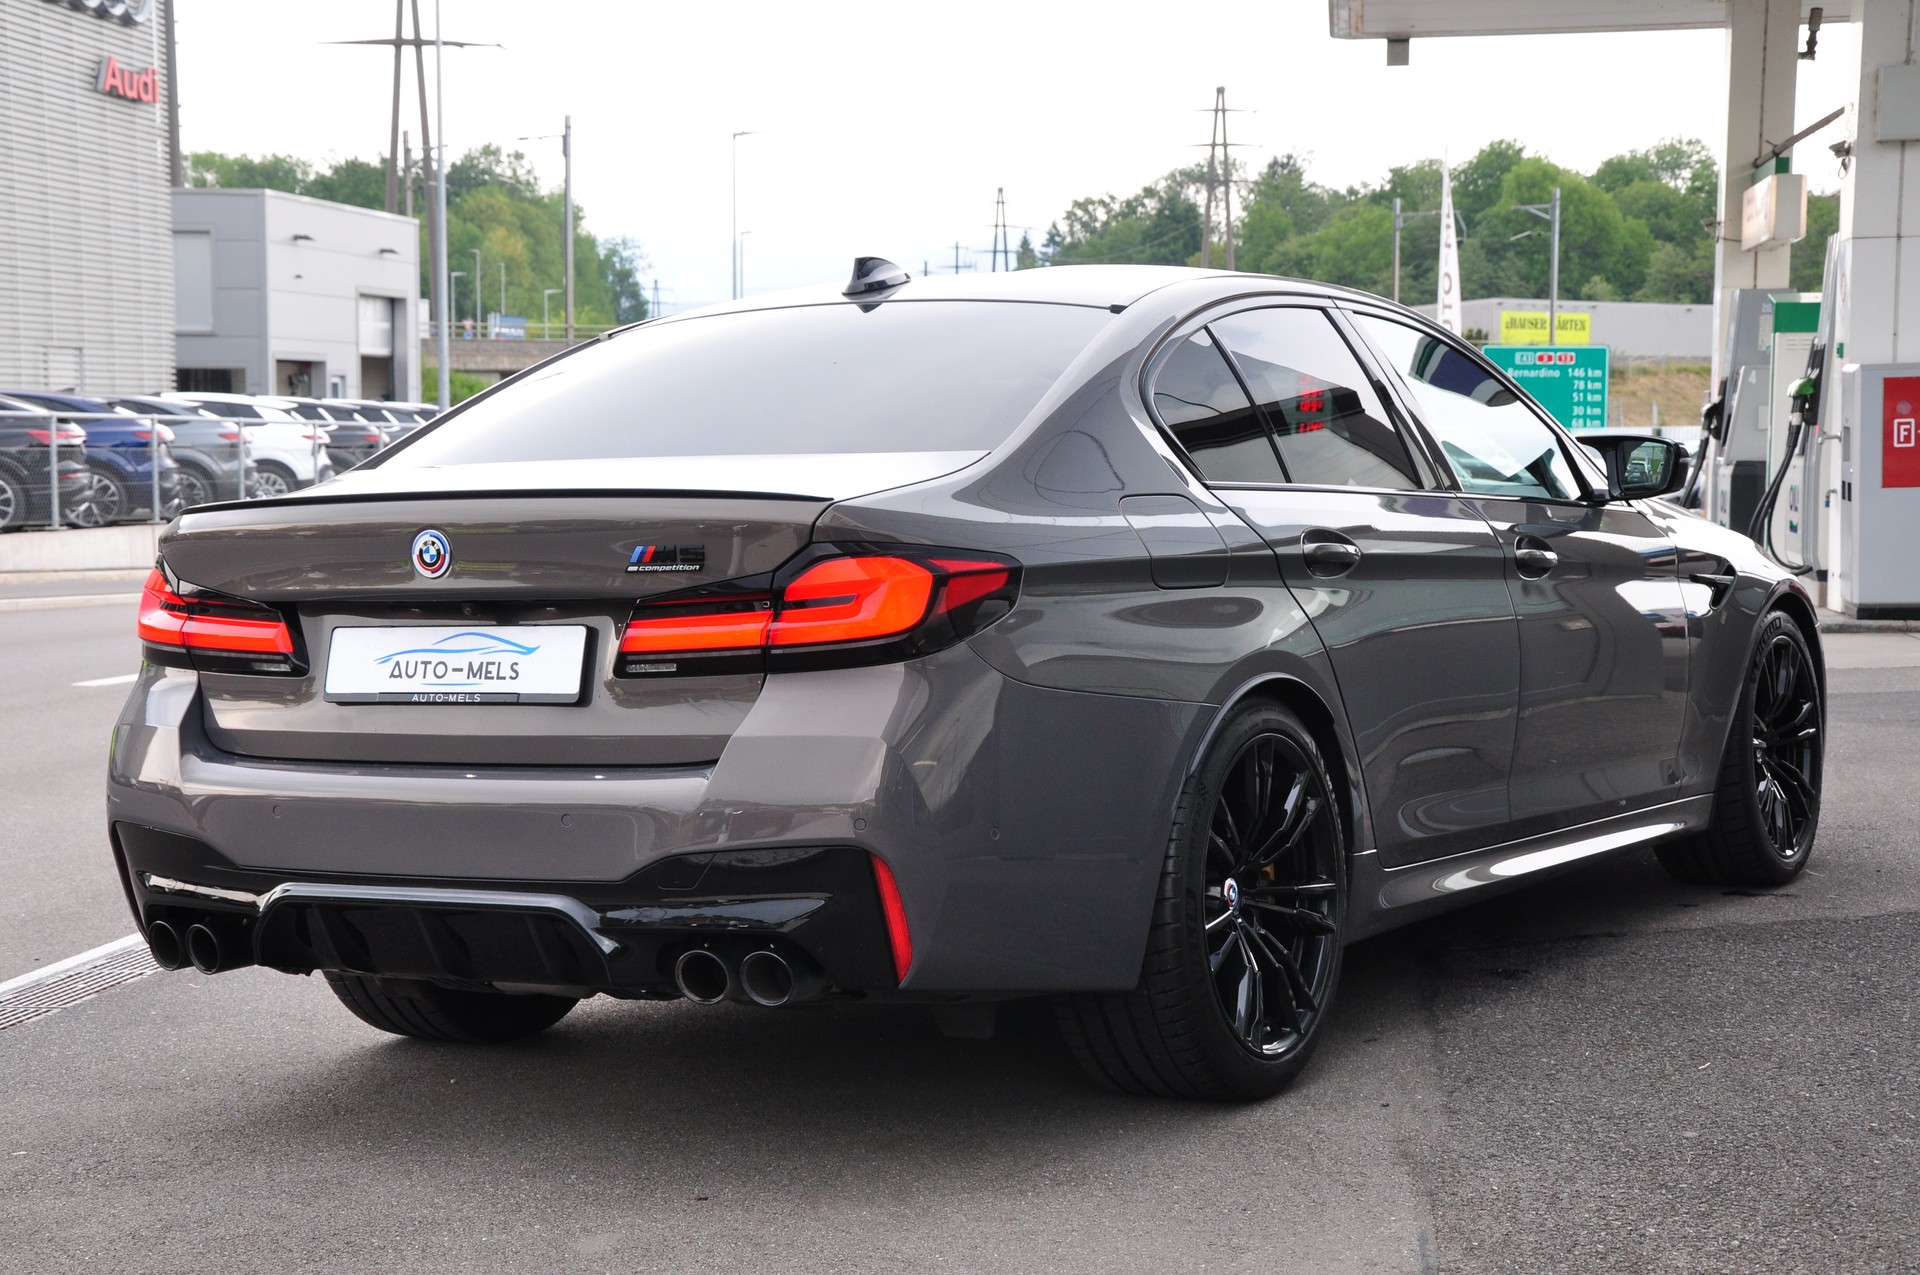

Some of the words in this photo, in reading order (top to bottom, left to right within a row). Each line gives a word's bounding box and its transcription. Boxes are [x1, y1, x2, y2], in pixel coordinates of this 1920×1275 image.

[103, 53, 160, 104] Audi
[1555, 315, 1586, 332] ÄRTEN
[1507, 368, 1561, 378] Bernardino
[1568, 368, 1585, 378] 146
[1587, 368, 1603, 378] km
[1748, 369, 1757, 385] 4
[1573, 380, 1585, 390] 78
[1587, 380, 1602, 390] km
[1572, 392, 1584, 402] 51
[1587, 392, 1602, 402] km
[1572, 405, 1584, 416] 30
[1586, 405, 1601, 416] km
[1586, 418, 1601, 429] km
[1900, 425, 1910, 442] F
[638, 564, 700, 573] competition
[389, 660, 519, 681] AUTO-MELS
[412, 693, 481, 702] AUTO-MELS
